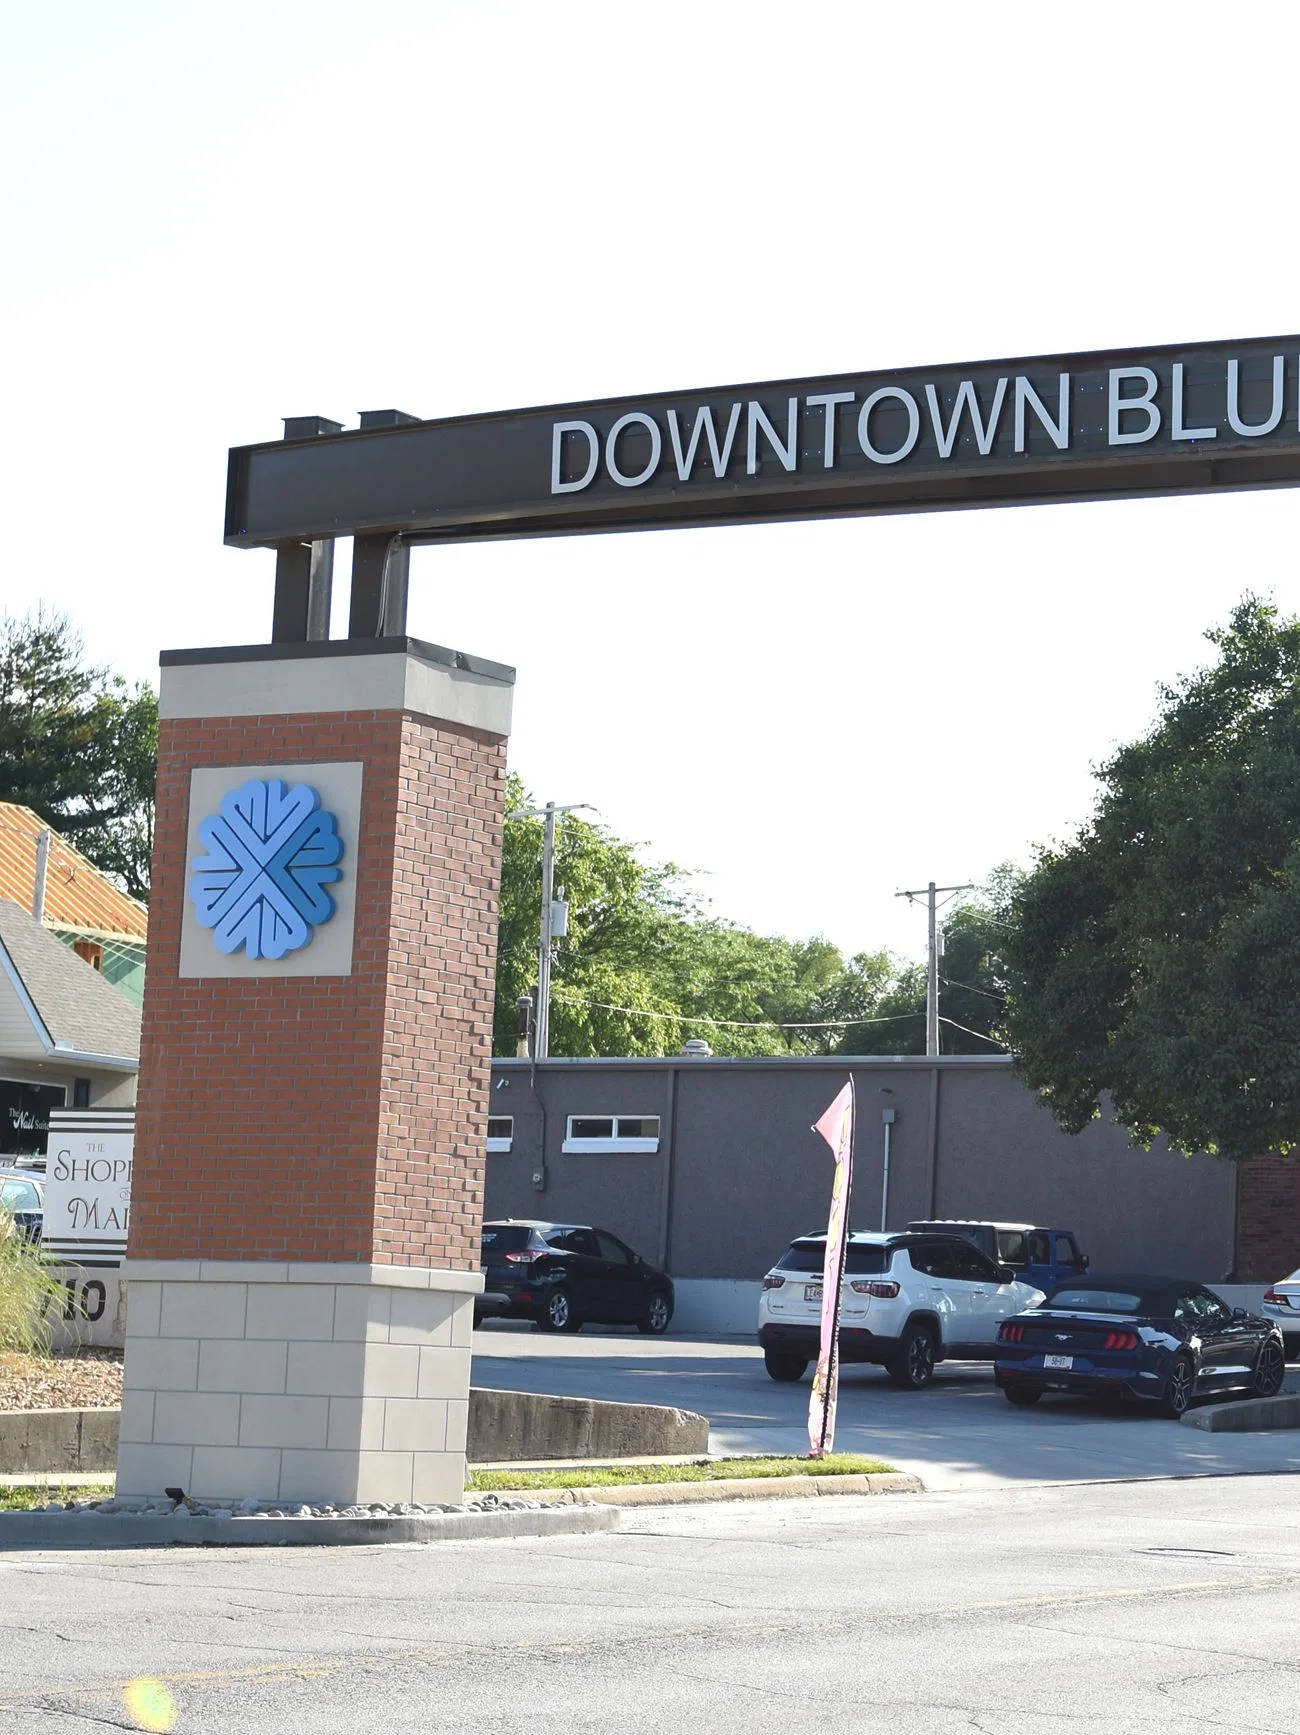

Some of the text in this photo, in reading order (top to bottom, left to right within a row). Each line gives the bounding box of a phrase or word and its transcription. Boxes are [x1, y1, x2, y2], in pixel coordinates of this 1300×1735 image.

[551, 372, 1070, 494] DOWNTOWN
[9, 1108, 20, 1118] The
[13, 1111, 35, 1130] Nail
[86, 1143, 105, 1153] THE
